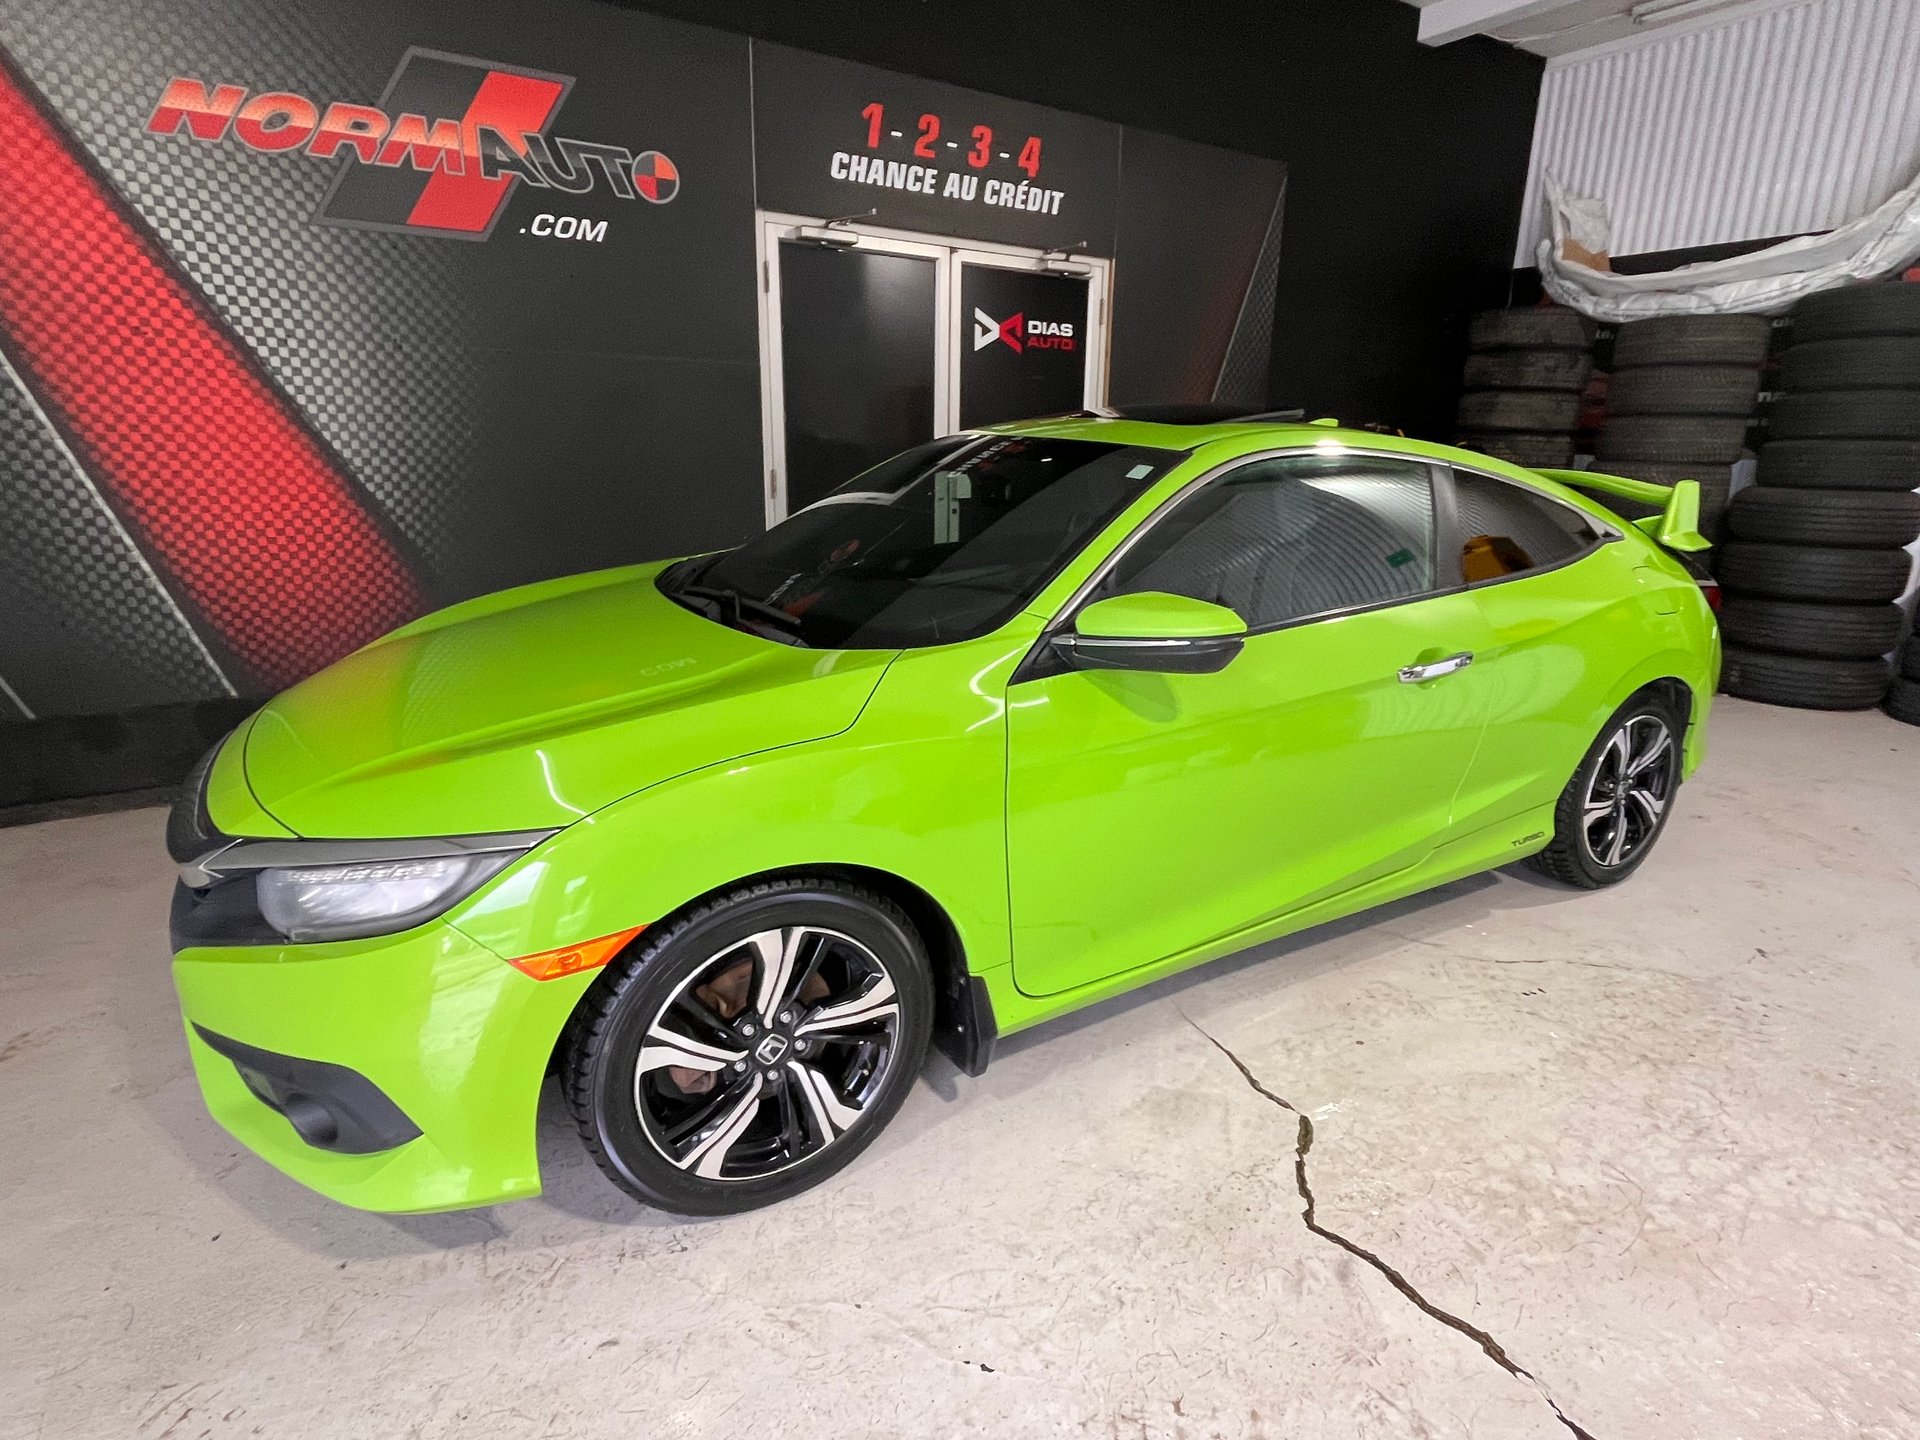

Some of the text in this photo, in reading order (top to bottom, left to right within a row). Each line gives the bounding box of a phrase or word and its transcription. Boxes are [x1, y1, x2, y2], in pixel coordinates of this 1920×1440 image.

[831, 151, 1065, 215] CHANCE AU CRÉDIT
[1028, 320, 1073, 336] DIAS
[1027, 337, 1074, 350] AUTO
